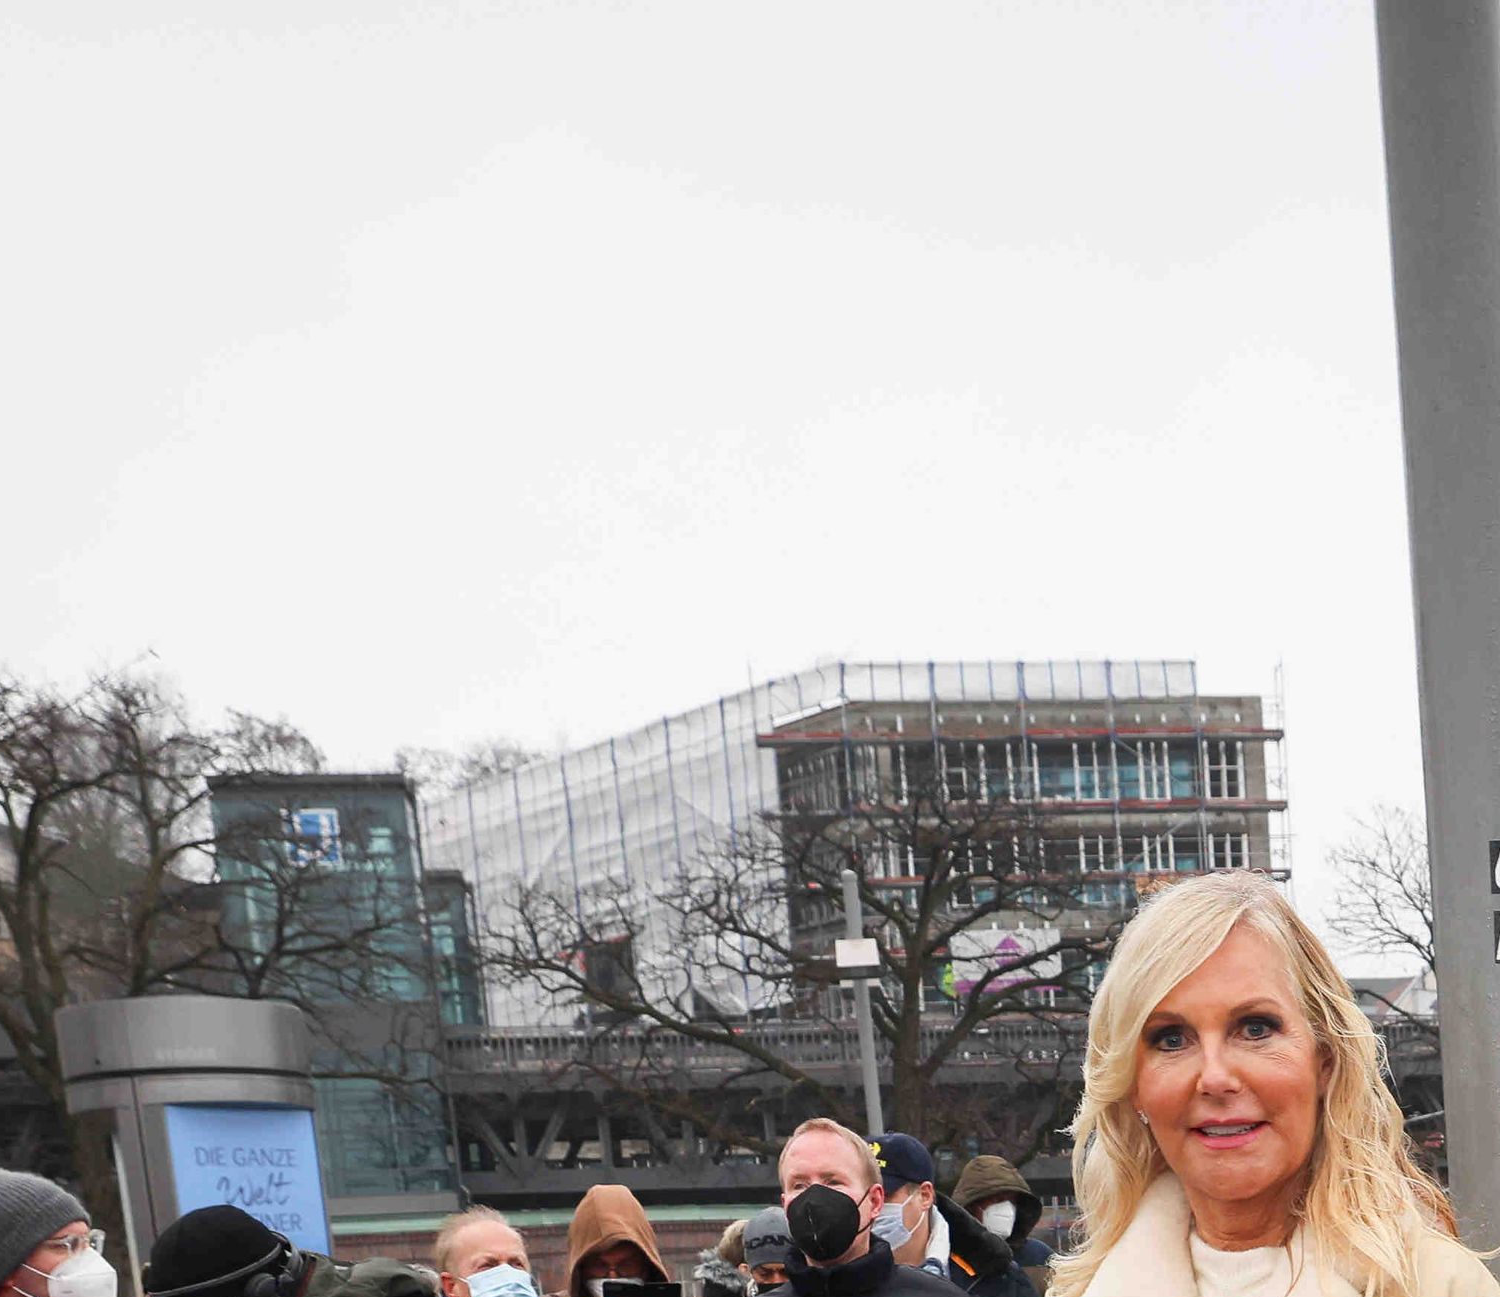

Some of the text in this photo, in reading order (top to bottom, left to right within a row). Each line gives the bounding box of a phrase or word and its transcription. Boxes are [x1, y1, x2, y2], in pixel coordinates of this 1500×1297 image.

[194, 1147, 299, 1168] DIE GANZE
[215, 1171, 292, 1206] Welt
